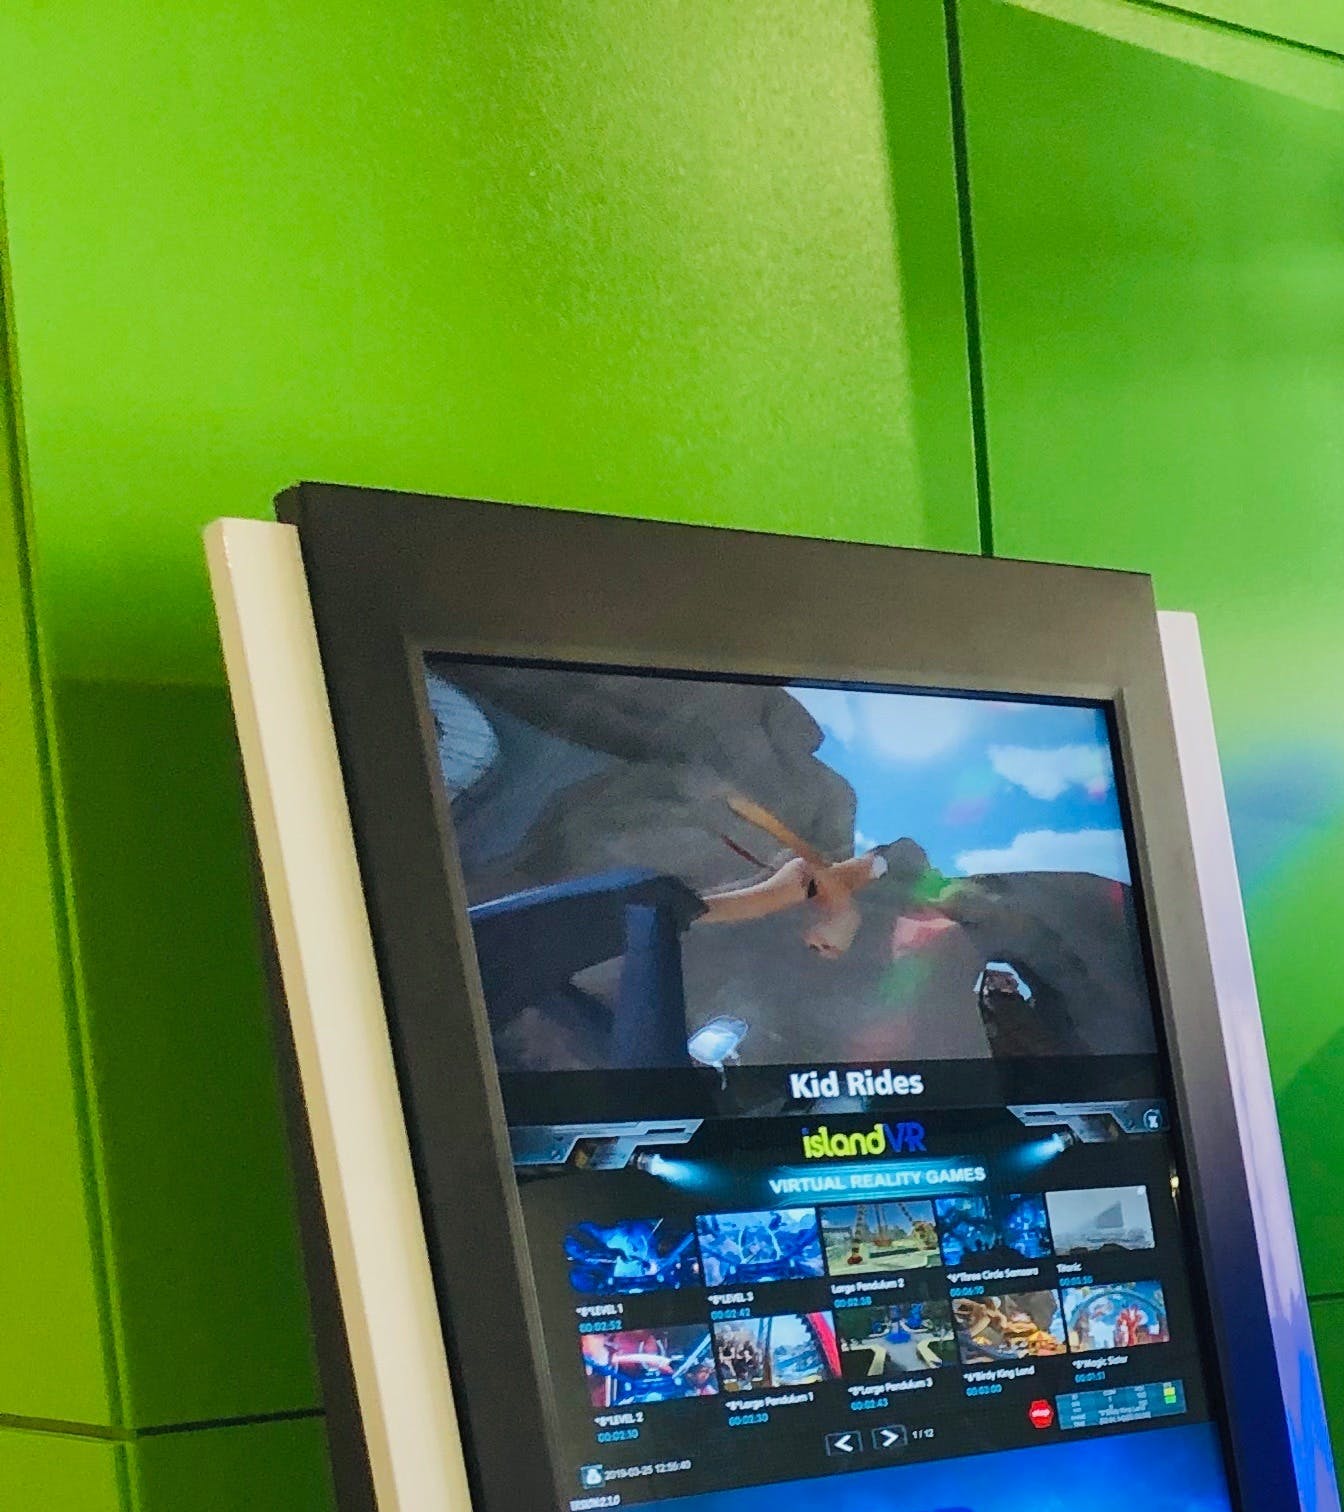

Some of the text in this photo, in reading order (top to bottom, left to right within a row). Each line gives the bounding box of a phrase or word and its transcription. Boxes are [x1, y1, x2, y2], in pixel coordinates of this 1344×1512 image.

[790, 1068, 924, 1099] Kid Rides
[769, 1167, 986, 1194] VIRTUAL REALITY GAMES
[831, 1283, 855, 1295] Large
